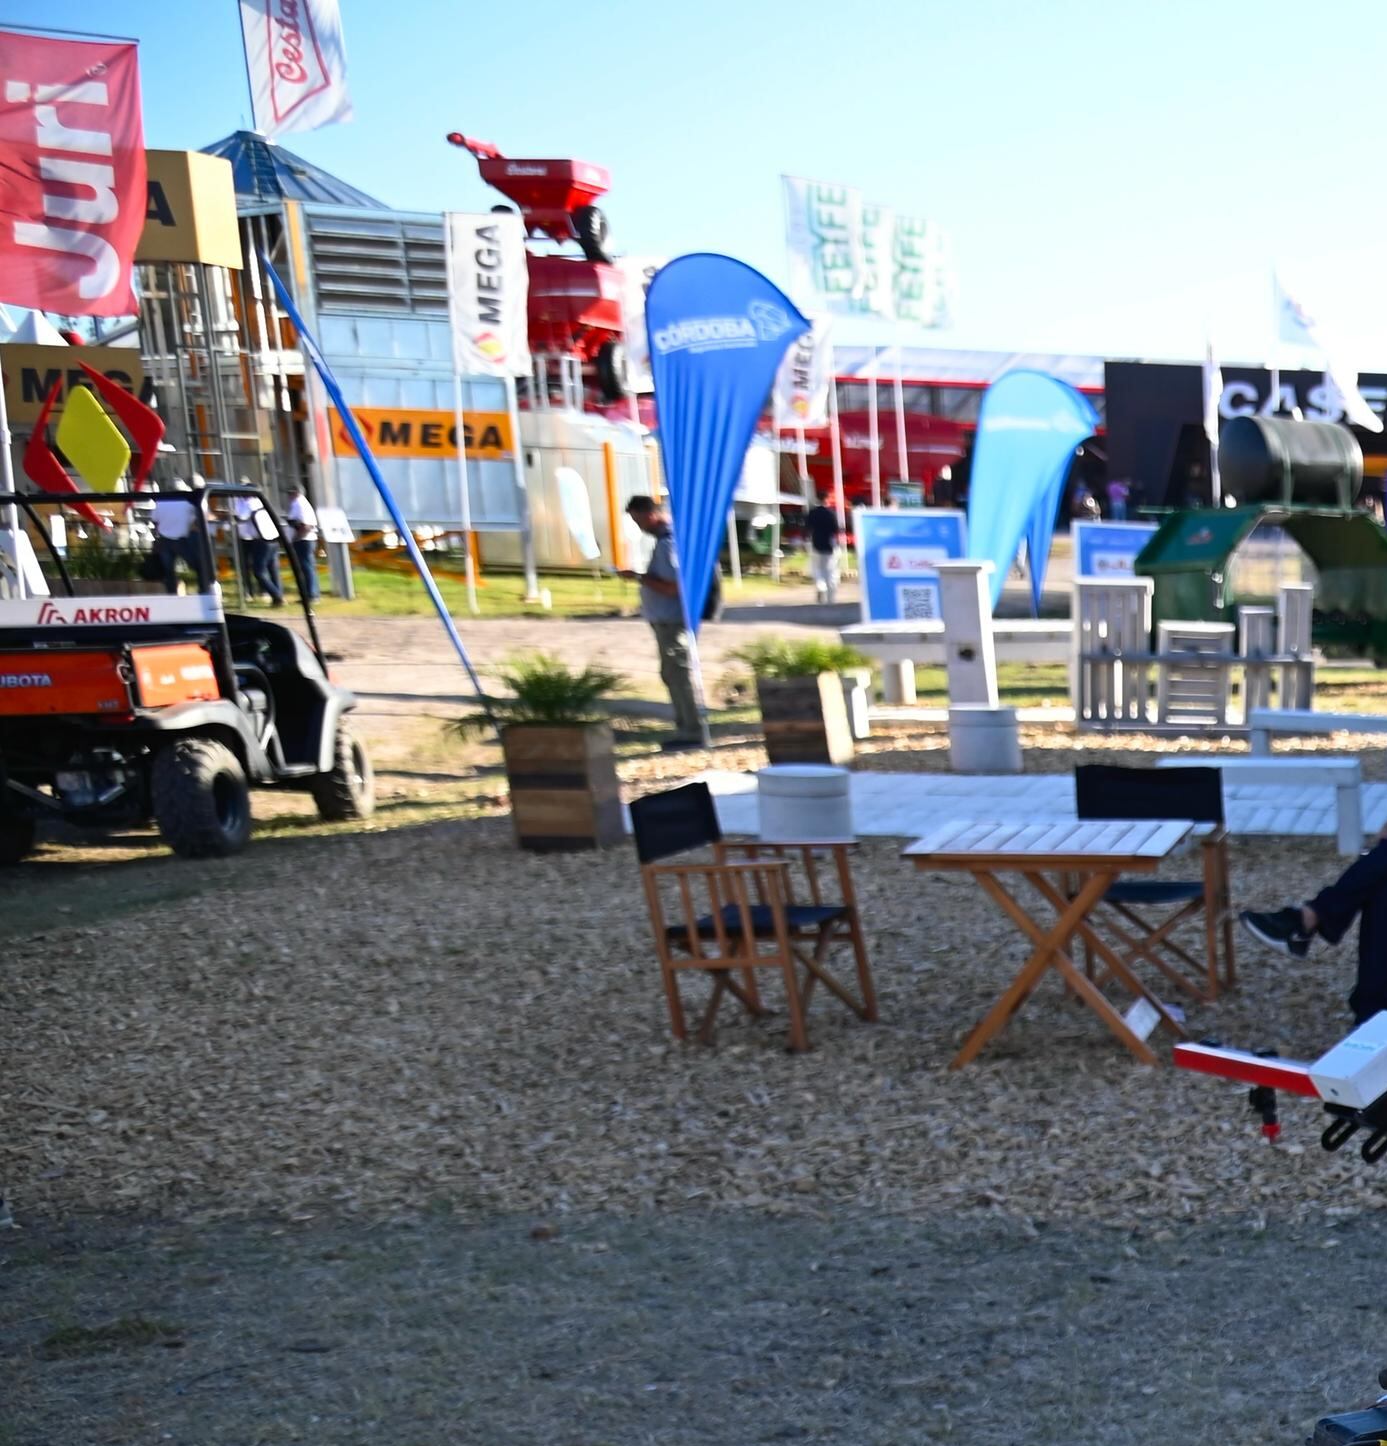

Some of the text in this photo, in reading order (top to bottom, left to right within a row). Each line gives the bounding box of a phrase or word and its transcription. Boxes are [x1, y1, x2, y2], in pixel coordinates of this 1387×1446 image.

[5, 80, 120, 299] Juri
[475, 224, 504, 326] MEGA
[792, 334, 815, 391] MEG
[379, 421, 503, 450] MEGA
[73, 607, 151, 625] AKRON
